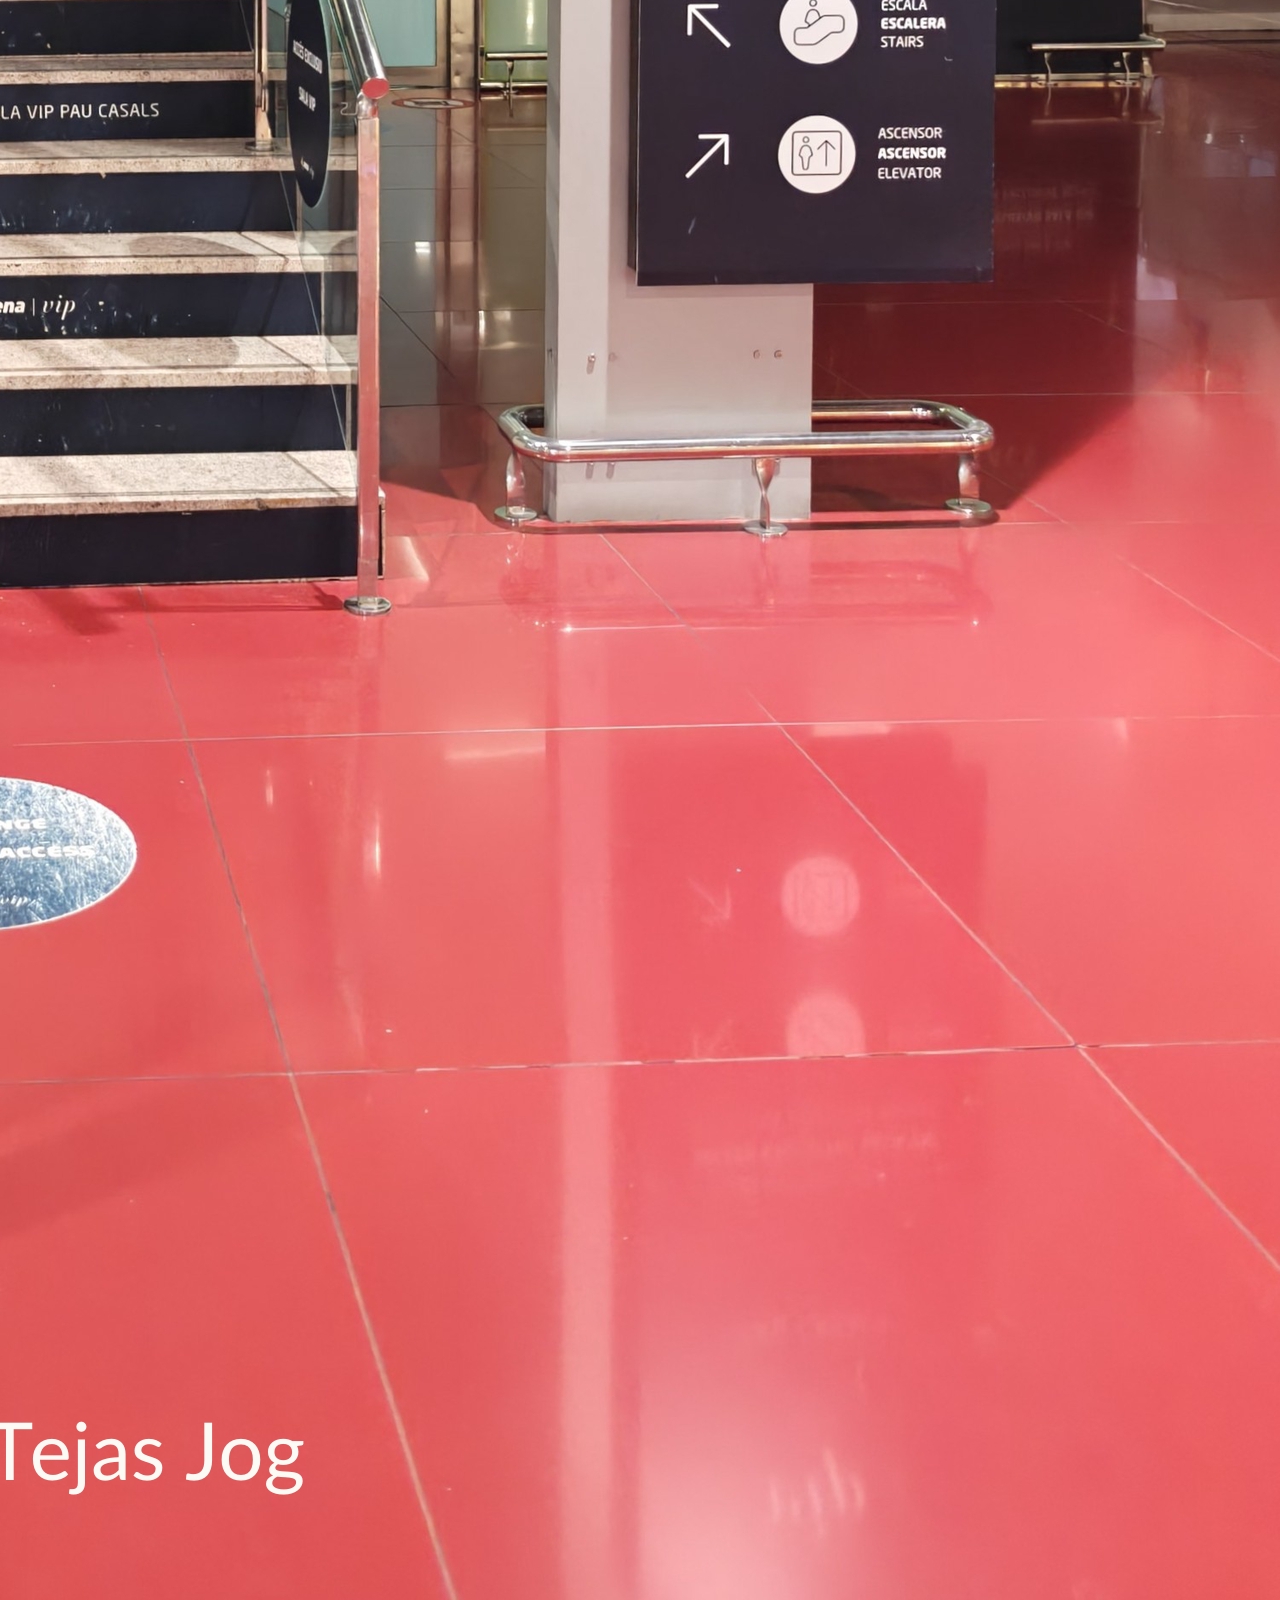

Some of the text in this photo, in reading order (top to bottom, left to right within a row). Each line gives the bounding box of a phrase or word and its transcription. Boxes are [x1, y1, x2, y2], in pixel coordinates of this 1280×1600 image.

[882, 0, 927, 11] ESCALA
[881, 17, 946, 29] ESCALERA
[881, 36, 923, 48] STAIRS
[27, 105, 54, 119] VIP
[61, 104, 91, 118] PAU
[99, 103, 159, 117] CASALS
[878, 127, 942, 139] ASCENSOR
[878, 147, 946, 159] ASCENSOR
[878, 167, 941, 179] ELEVATOR
[41, 294, 76, 316] vip
